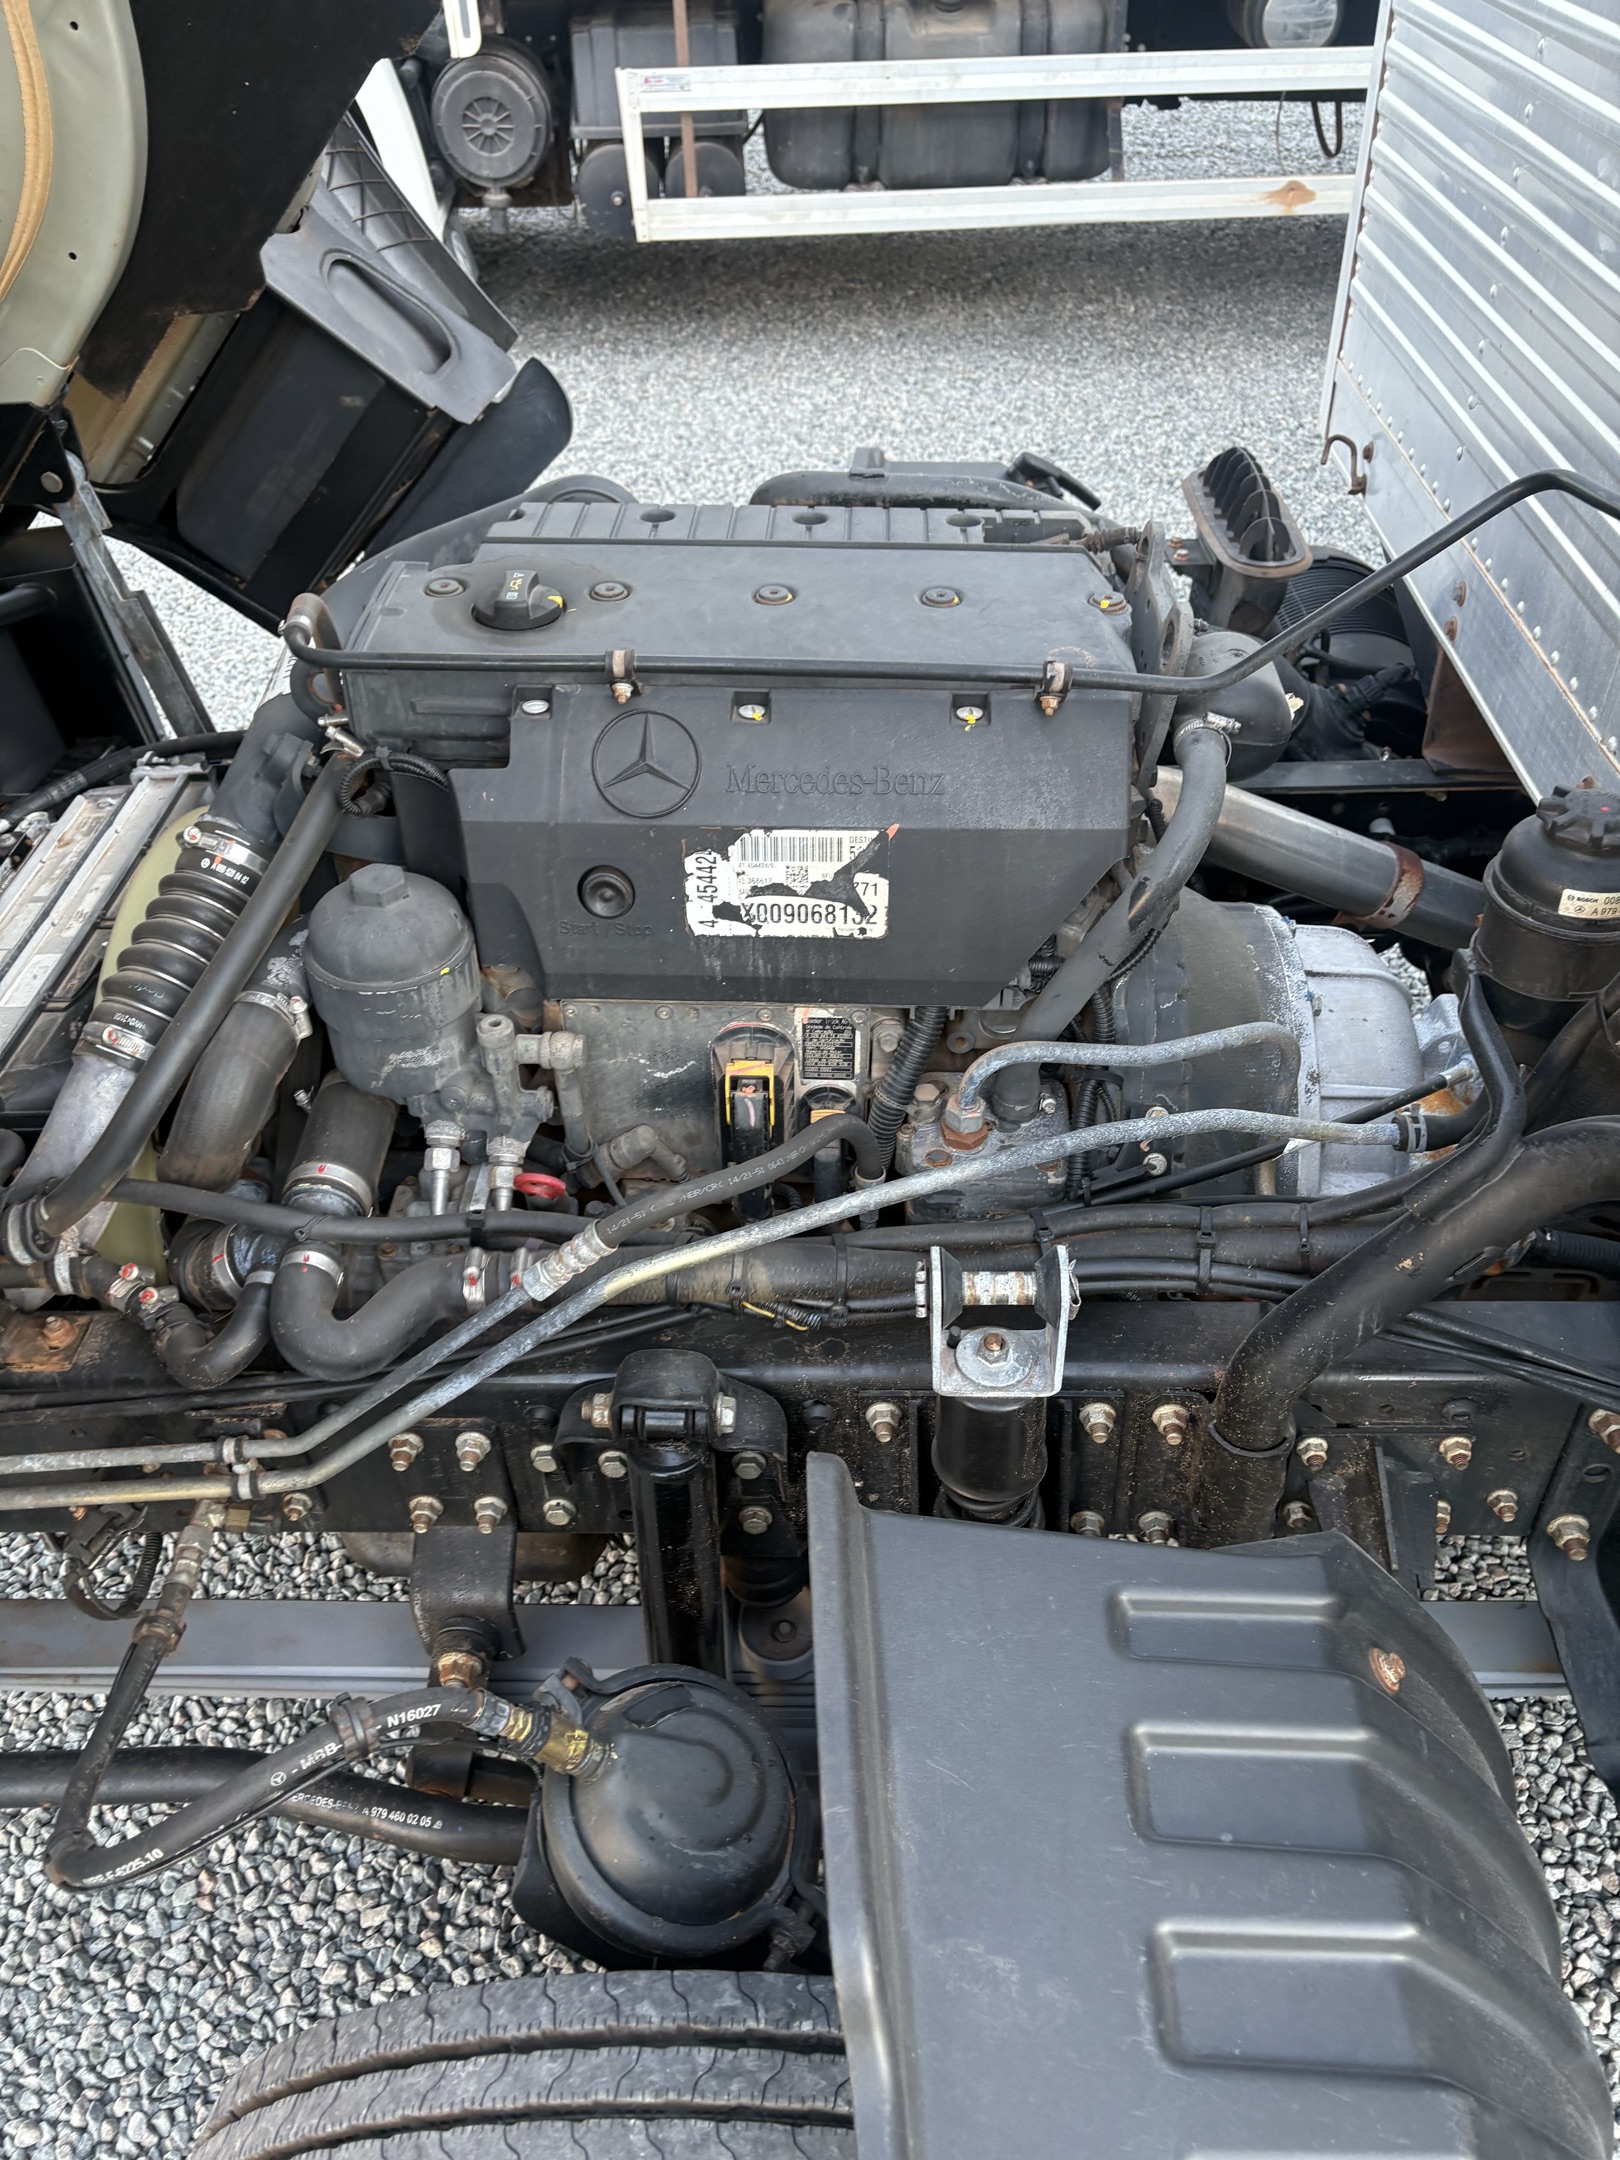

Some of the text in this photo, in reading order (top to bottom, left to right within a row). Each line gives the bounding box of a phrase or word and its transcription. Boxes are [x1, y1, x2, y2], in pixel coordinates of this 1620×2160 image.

[725, 764, 948, 796] Mercedes-Benz
[1600, 907, 1618, 916] 979
[387, 1703, 442, 1728] N16027
[290, 1793, 359, 1814] ERCEDES-BENZ
[370, 1806, 389, 1819] 979
[388, 1810, 407, 1823] 460
[406, 1812, 420, 1825] 02
[419, 1815, 433, 1828] 05
